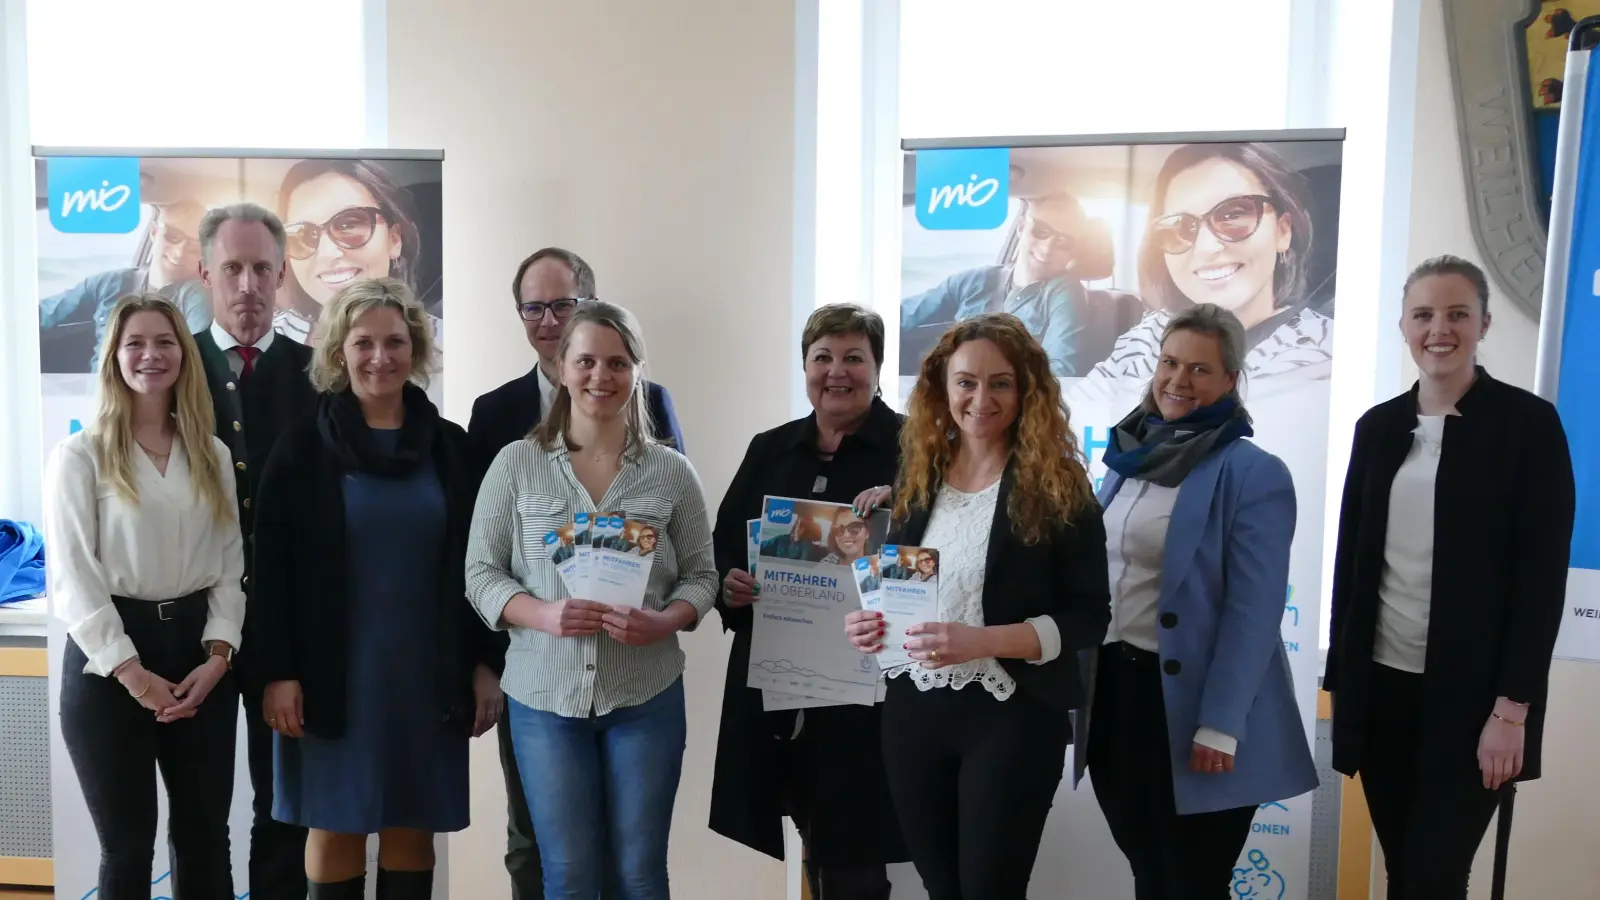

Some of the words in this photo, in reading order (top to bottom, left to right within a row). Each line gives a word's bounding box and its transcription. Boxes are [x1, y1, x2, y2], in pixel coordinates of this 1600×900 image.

[61, 180, 131, 217] mio
[928, 174, 999, 214] mio
[770, 508, 791, 518] mio
[603, 555, 640, 568] MITFAHREN
[764, 569, 837, 588] MITFAHREN
[763, 582, 777, 593] IM
[780, 585, 845, 602] OBERLAND
[886, 585, 926, 594] MITFAHREN
[1252, 823, 1290, 835] ONEN
